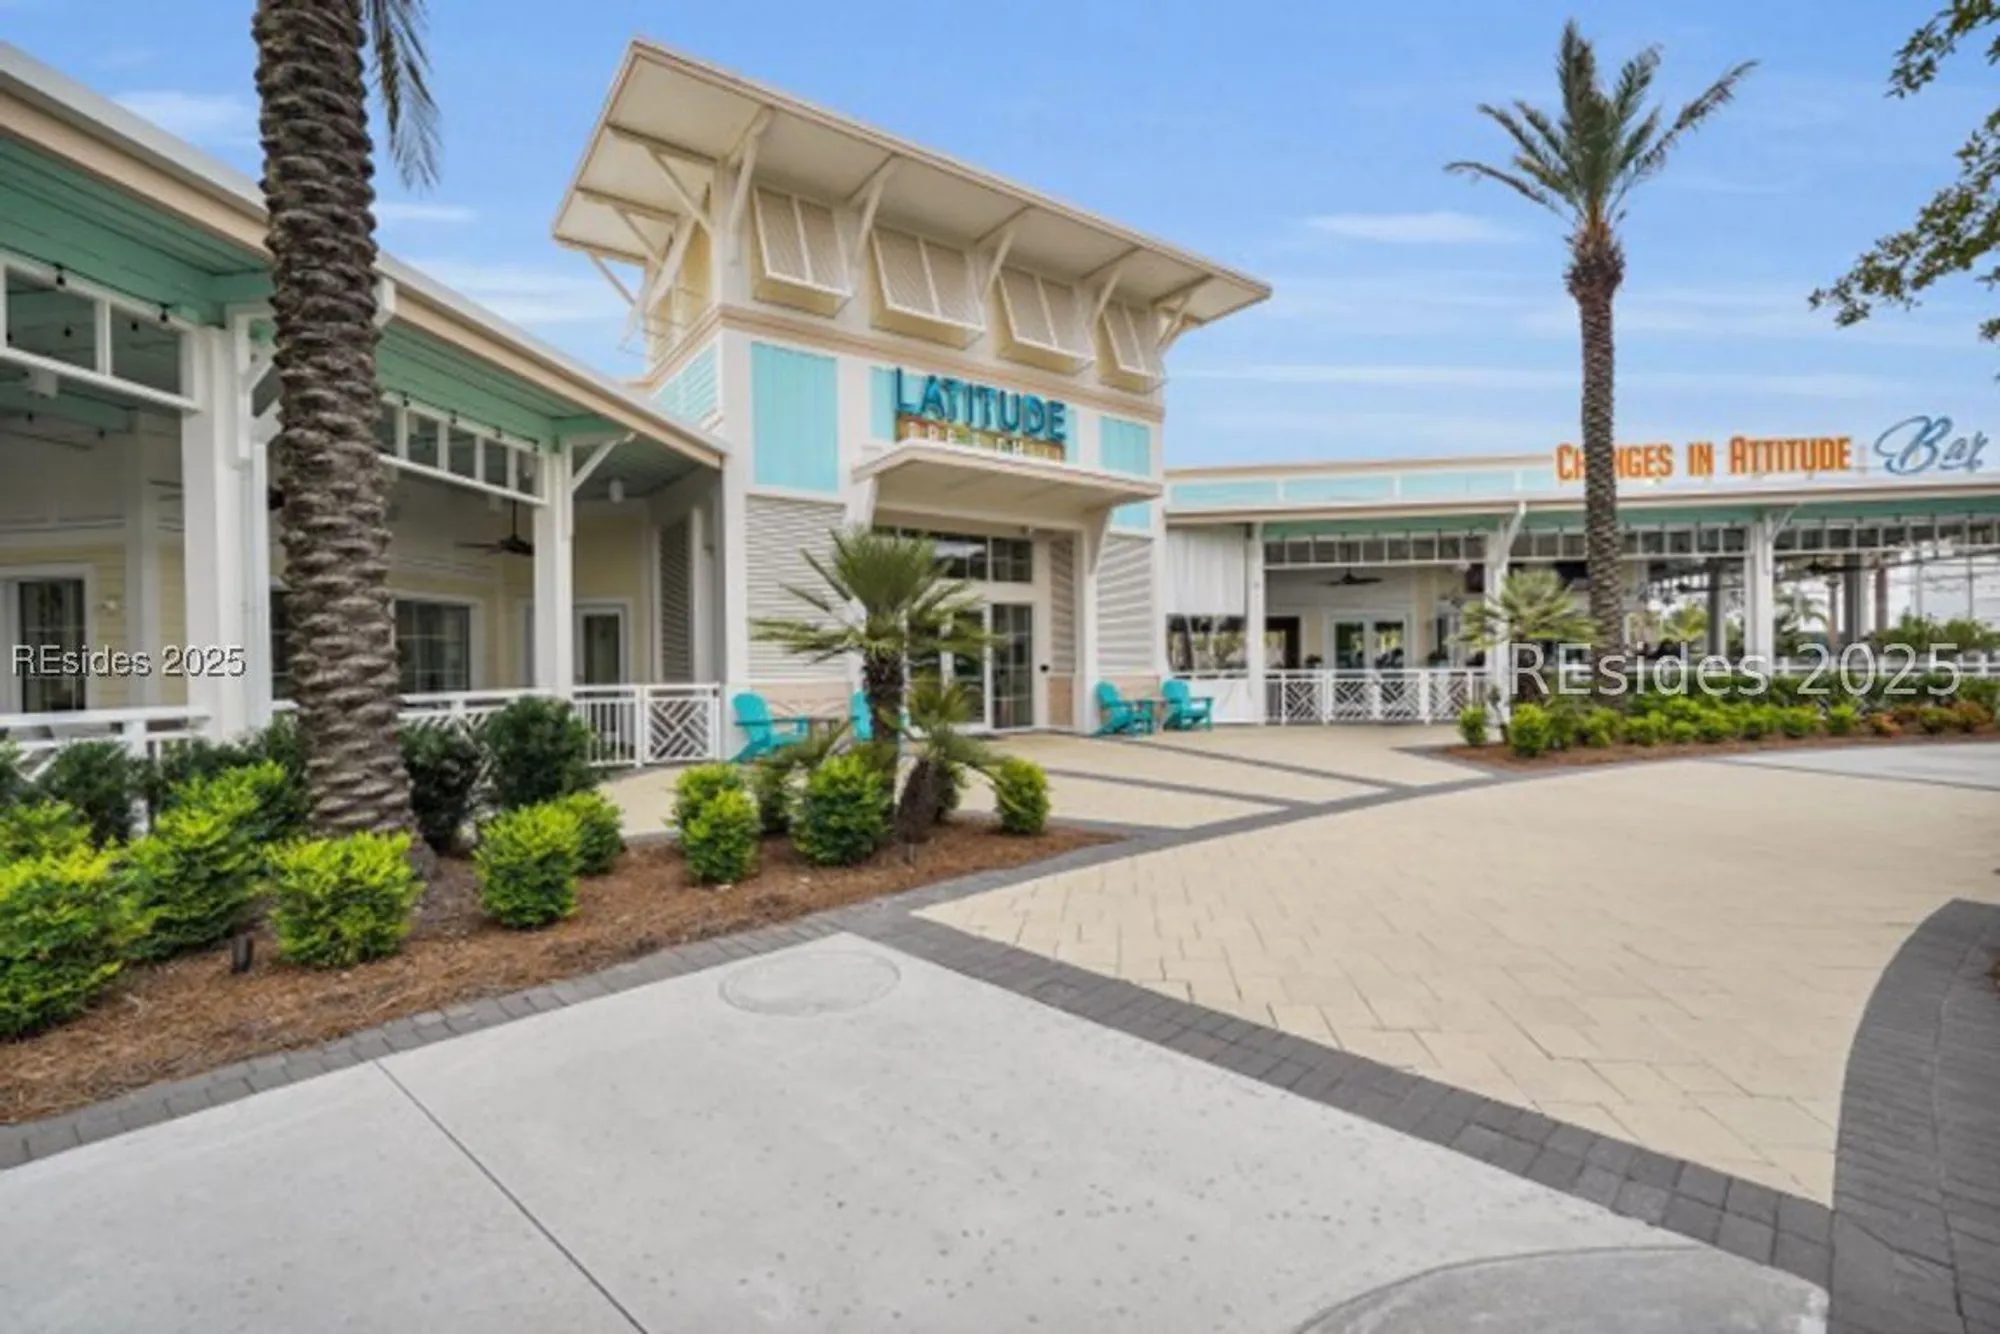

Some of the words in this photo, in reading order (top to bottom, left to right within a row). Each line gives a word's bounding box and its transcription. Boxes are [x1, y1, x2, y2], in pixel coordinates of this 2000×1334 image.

[896, 367, 1066, 441] LATITUDE
[1556, 443, 1673, 481] CHNGES
[1688, 443, 1713, 476] IN
[1730, 436, 1851, 474] ATTITUDE
[1874, 416, 1989, 477] Bar
